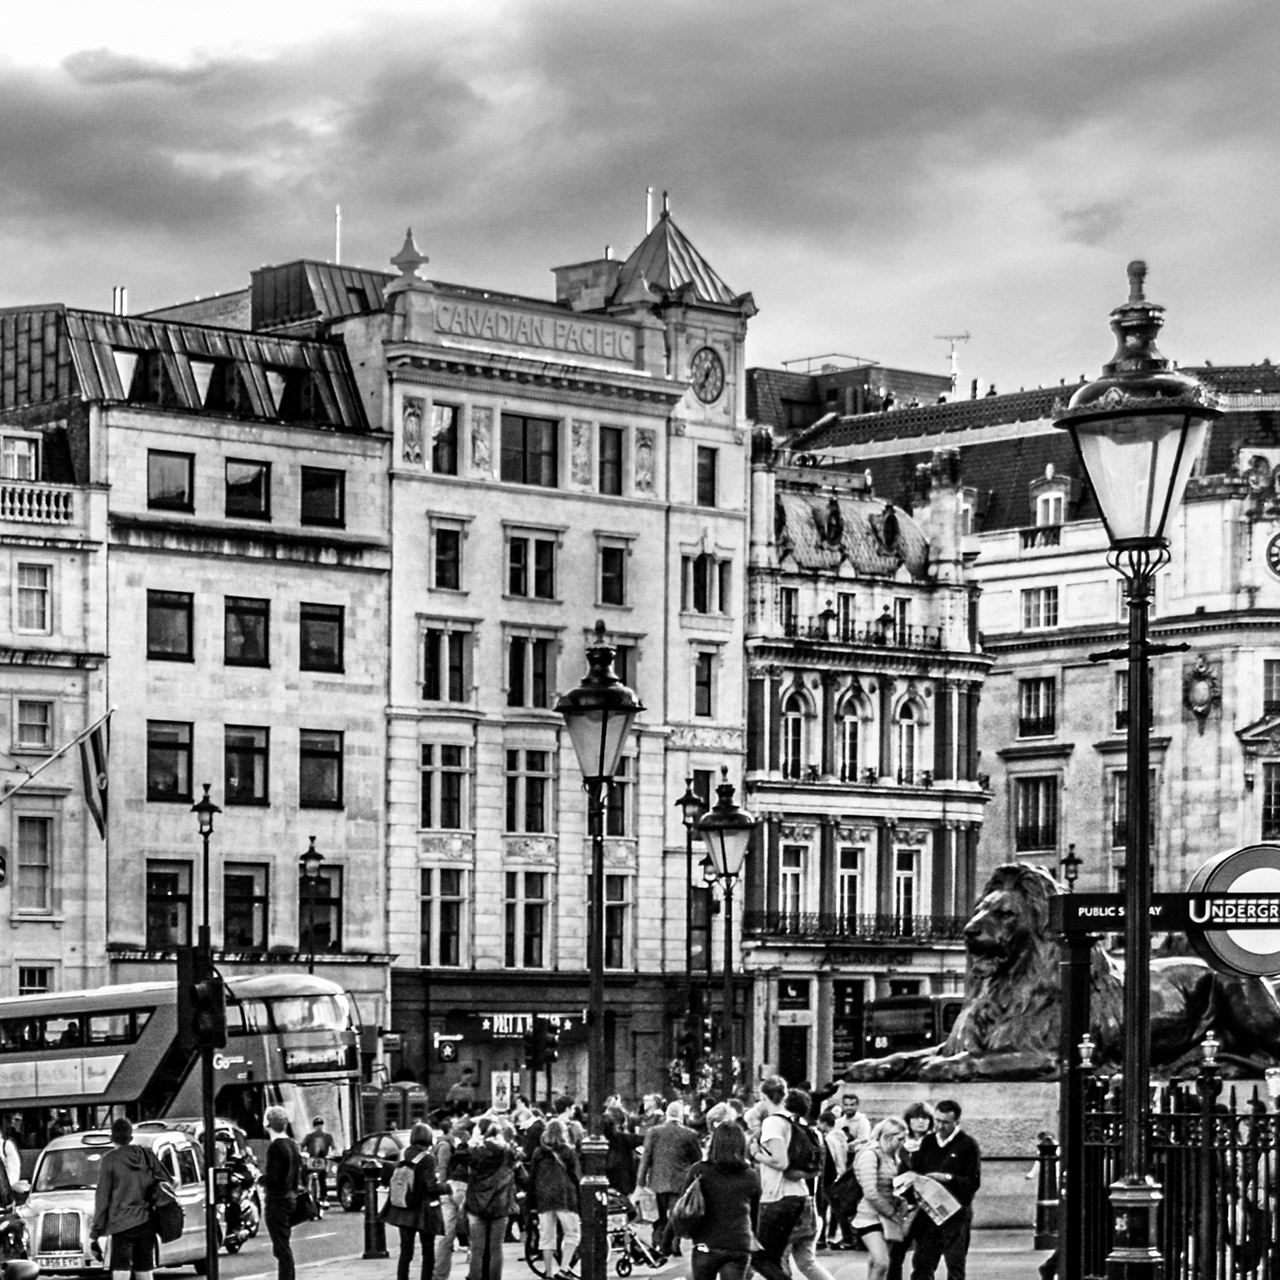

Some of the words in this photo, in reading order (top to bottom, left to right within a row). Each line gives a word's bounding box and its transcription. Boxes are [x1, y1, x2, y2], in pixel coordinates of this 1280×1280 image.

[435, 304, 545, 347] CANADIAN
[553, 320, 633, 360] PACIFIC
[1078, 906, 1116, 917] PUBLIC
[1118, 906, 1162, 917] SAY
[213, 1054, 230, 1069] Go
